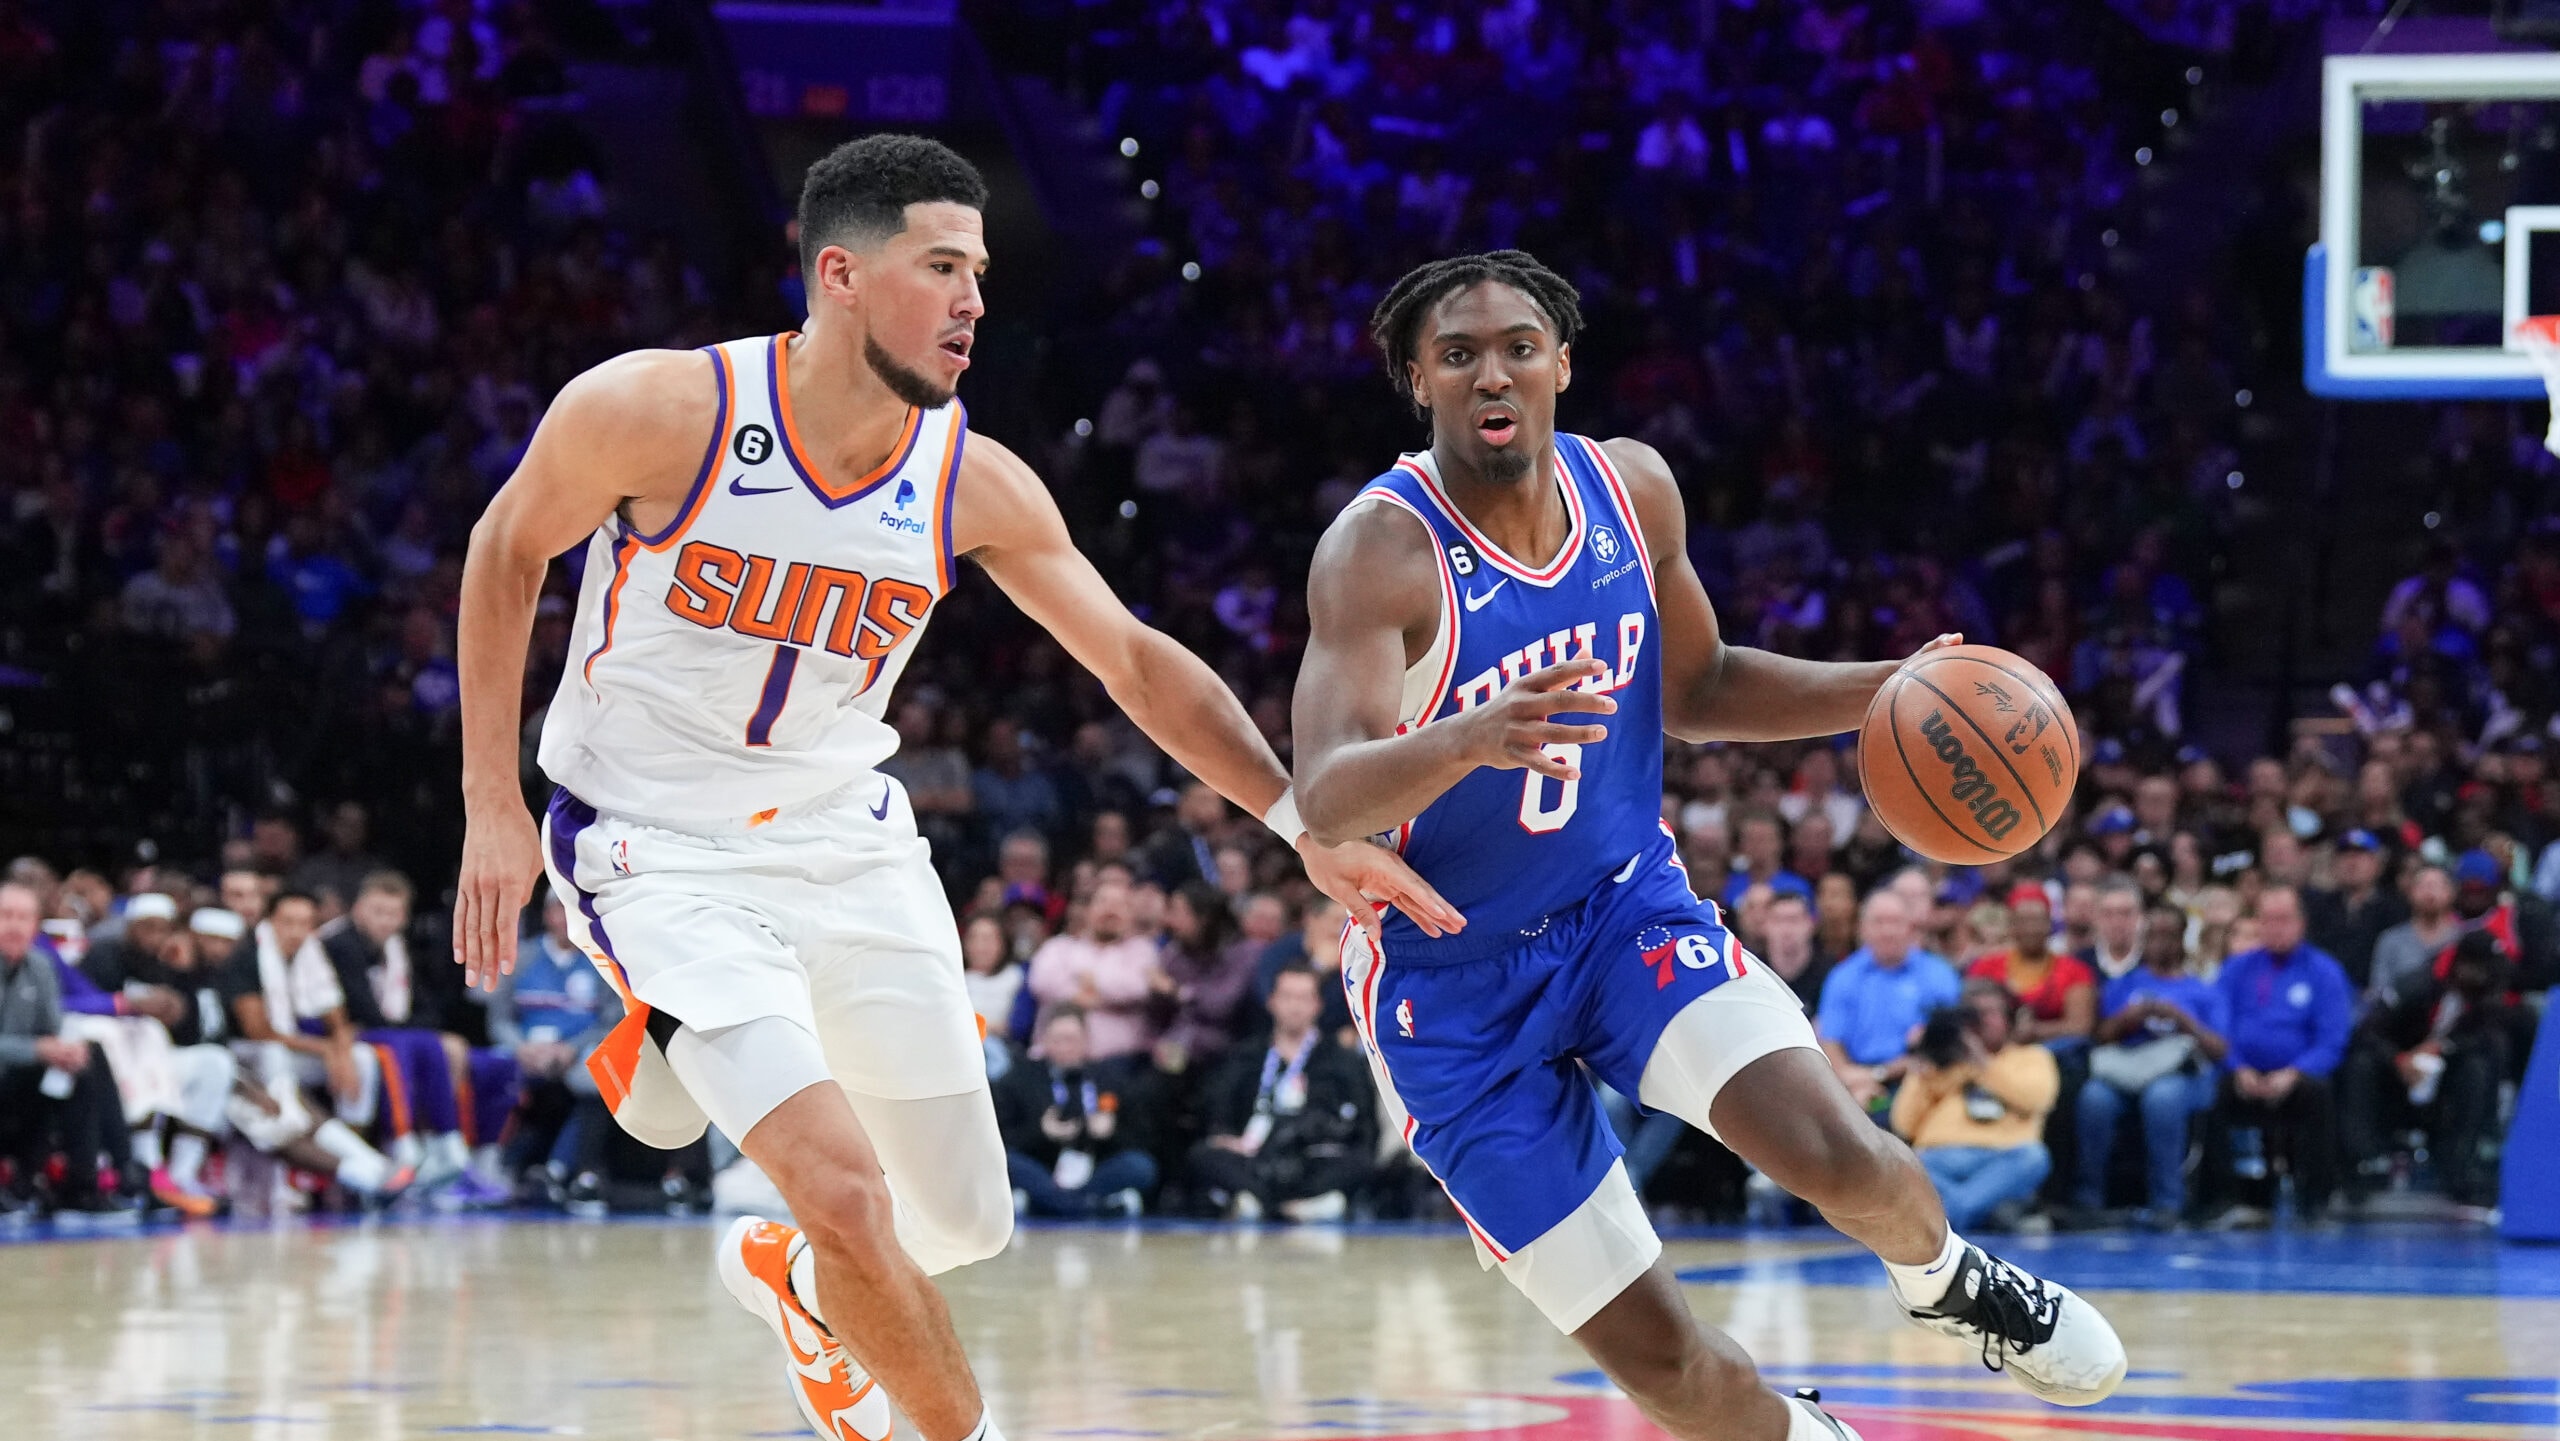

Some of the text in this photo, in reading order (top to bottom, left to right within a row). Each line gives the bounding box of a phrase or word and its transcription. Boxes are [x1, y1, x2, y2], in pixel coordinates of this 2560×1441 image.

[740, 429, 766, 461] 6
[879, 511, 926, 534] PayPal
[1449, 545, 1473, 575] 6
[1592, 559, 1638, 589] crypto.com
[664, 540, 933, 660] SUNS
[745, 643, 801, 747] 1
[1517, 742, 1583, 836] 0
[1920, 709, 2021, 840] Wilson
[1640, 933, 1720, 991] 76
